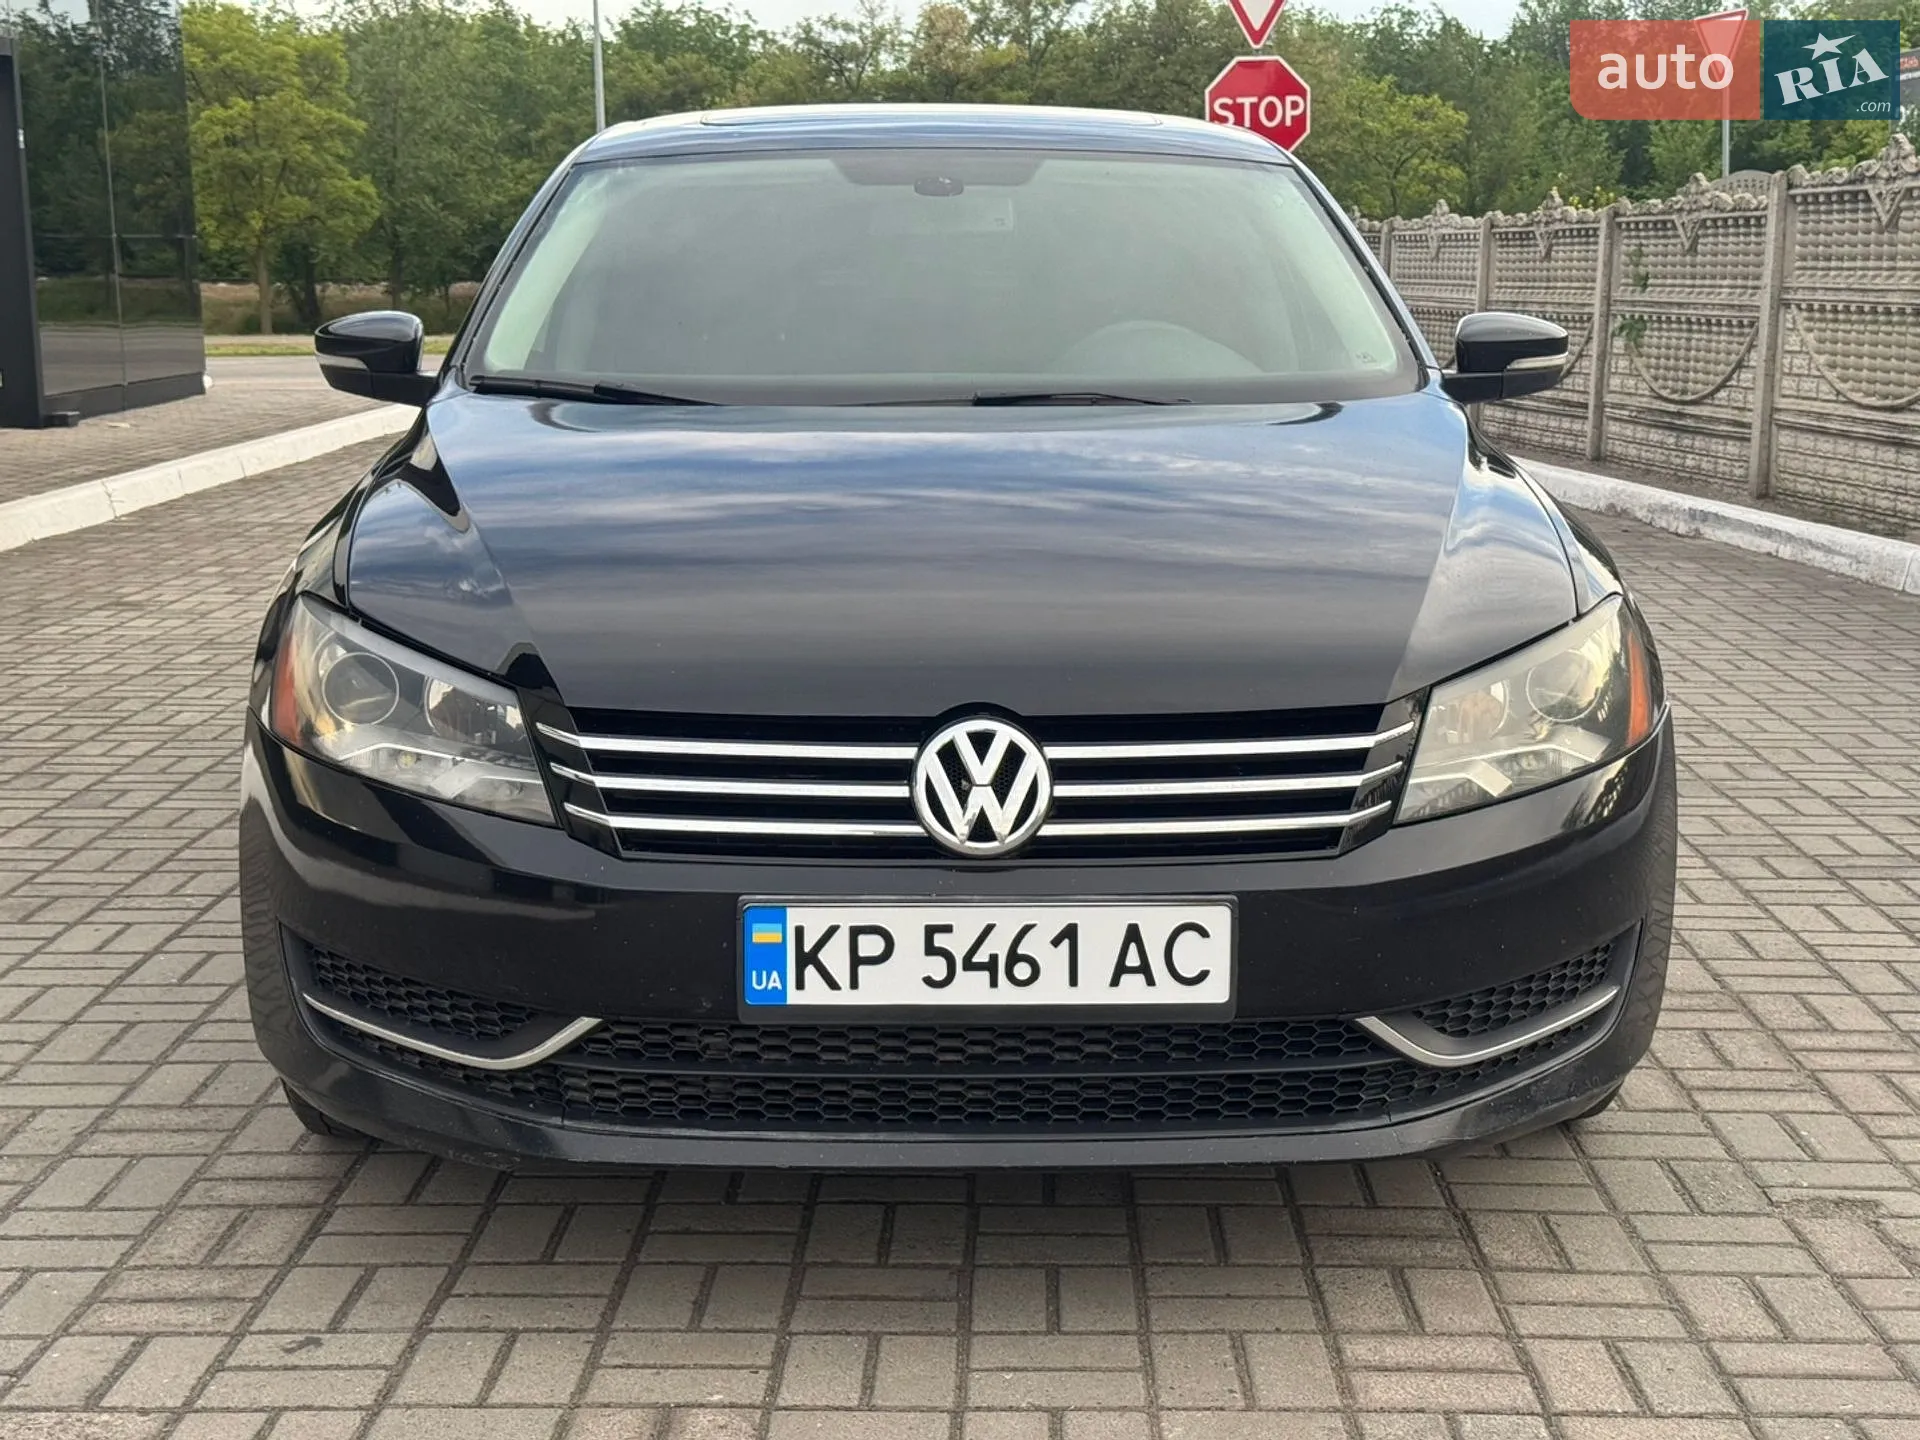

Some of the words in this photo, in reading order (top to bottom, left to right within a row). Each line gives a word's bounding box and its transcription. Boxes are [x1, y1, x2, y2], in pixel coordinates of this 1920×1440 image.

[1213, 94, 1306, 129] STOP
[918, 723, 1046, 850] VW
[751, 970, 783, 991] UA
[794, 923, 896, 992] KP
[921, 922, 1079, 990] 5461
[1108, 921, 1212, 988] AC
